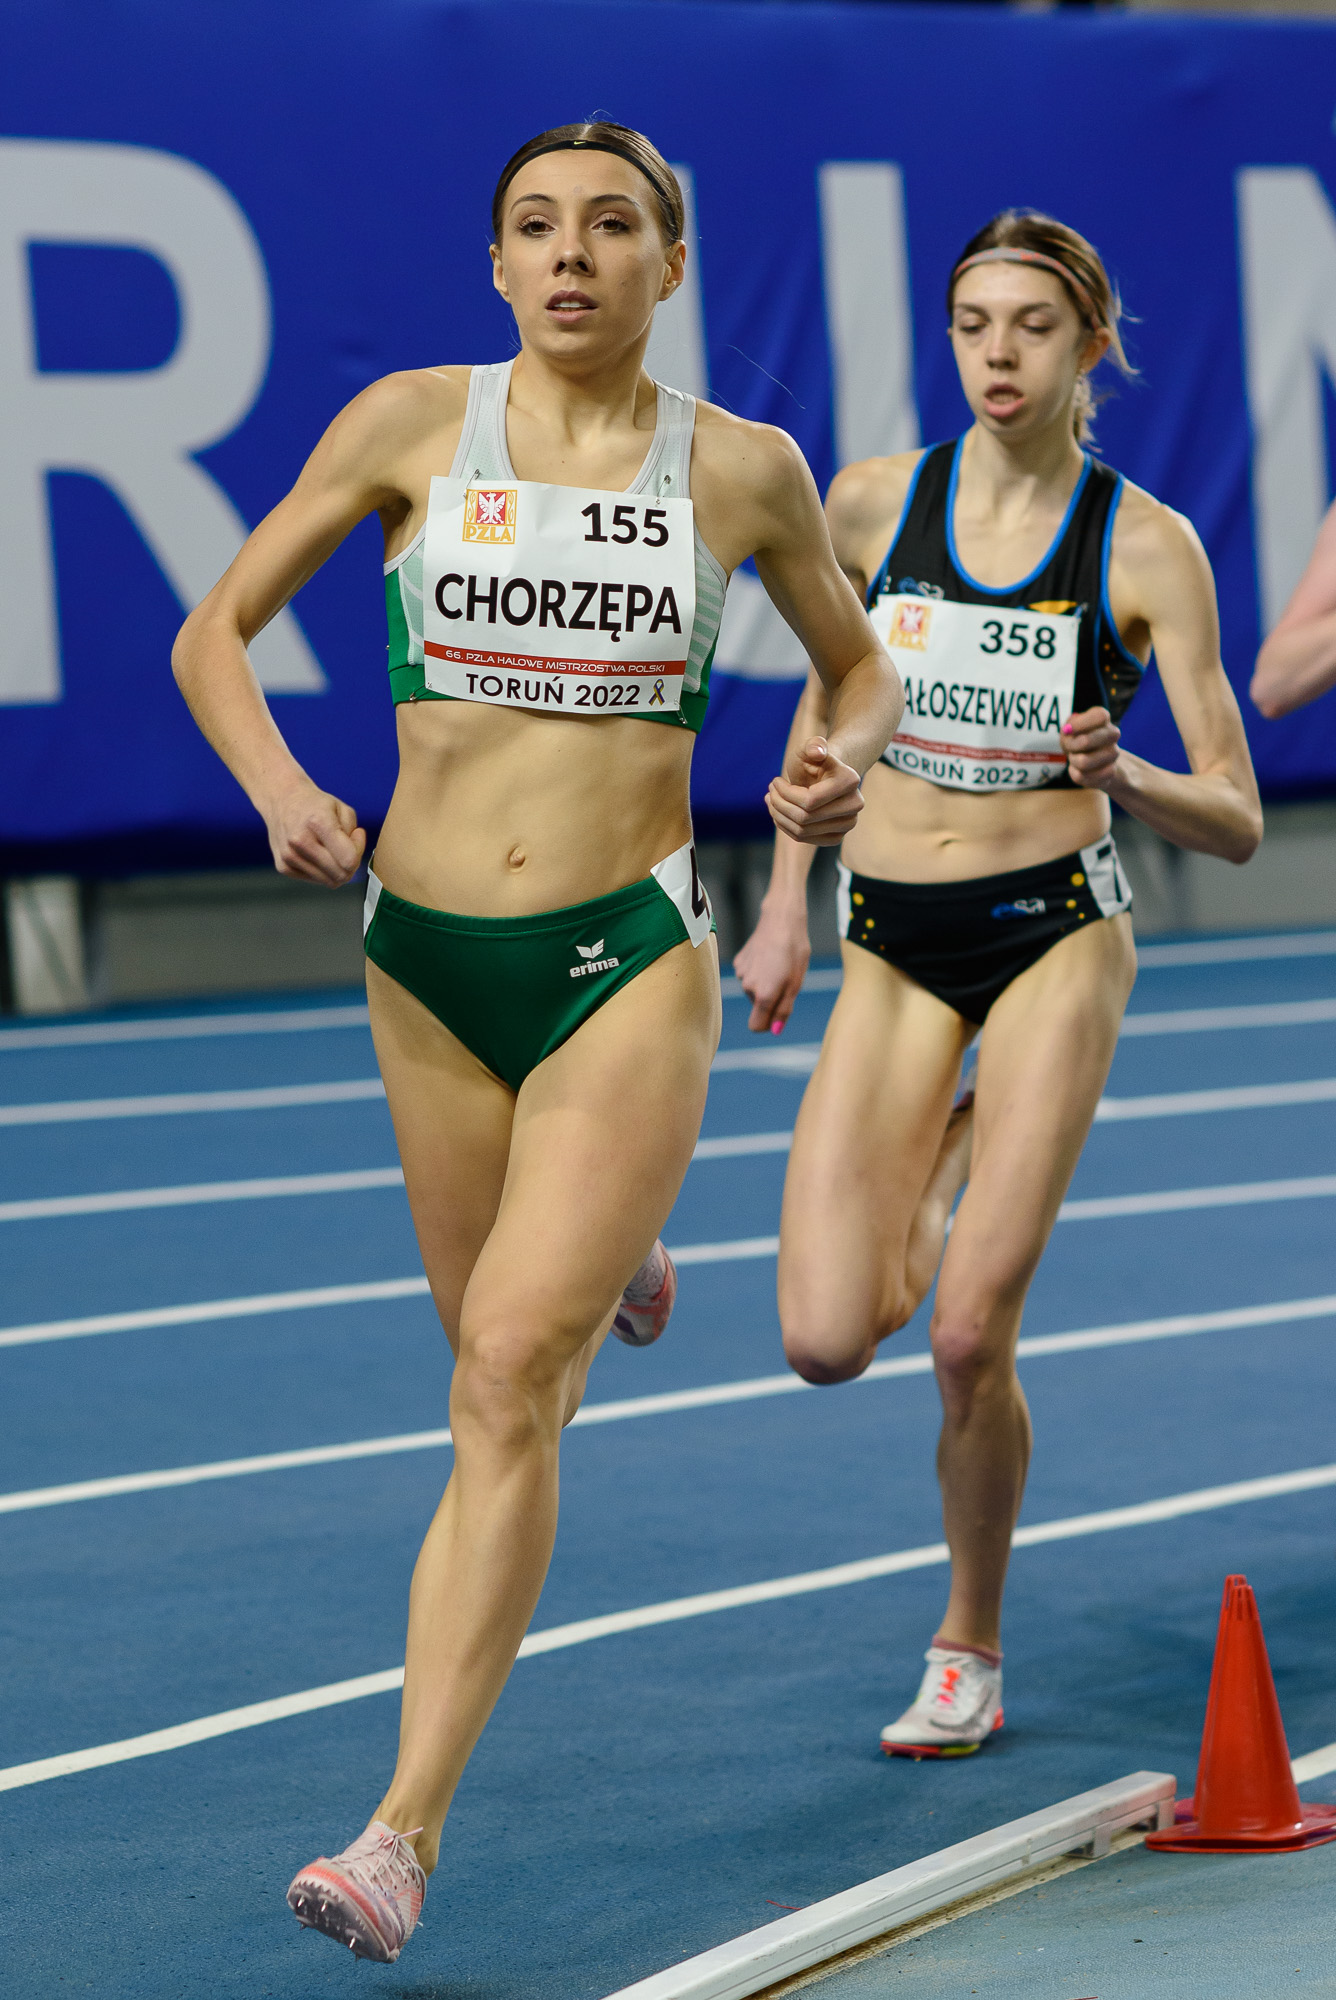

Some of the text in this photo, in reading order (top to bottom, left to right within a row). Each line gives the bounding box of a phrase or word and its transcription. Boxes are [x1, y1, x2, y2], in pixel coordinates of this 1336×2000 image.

[465, 525, 512, 541] PZLA
[581, 502, 669, 547] 155
[434, 573, 682, 643] CHORZĘPA
[980, 620, 1057, 660] 358
[445, 649, 666, 673] 66. PZLA HALOWE MISTRZOSTWA POLSKI
[466, 673, 641, 707] TORUŃ 2022
[904, 676, 1061, 733] AŁOSZEWSKA
[892, 748, 964, 781] TORUŃ
[973, 767, 1028, 784] 2022
[569, 957, 620, 978] erima
